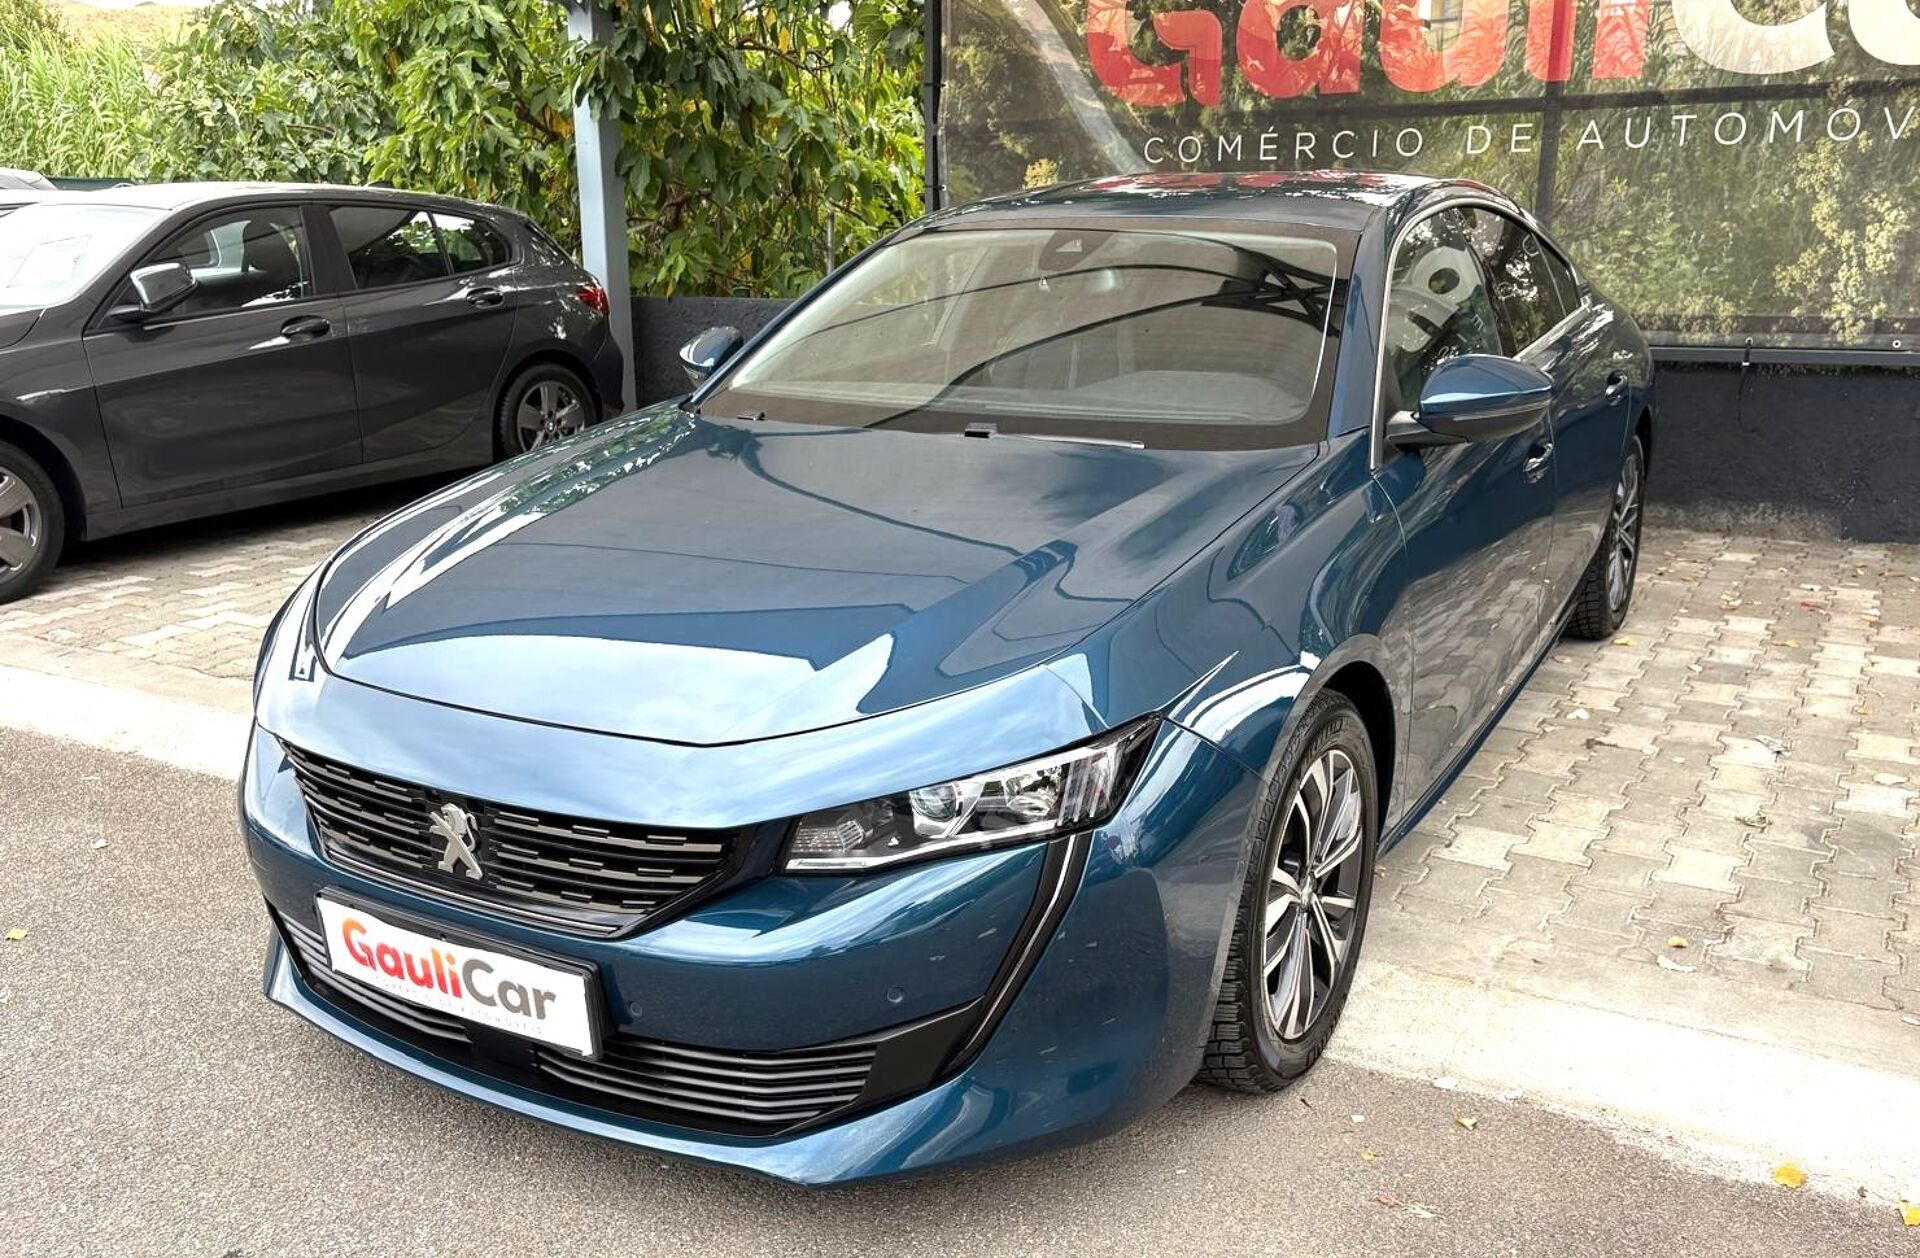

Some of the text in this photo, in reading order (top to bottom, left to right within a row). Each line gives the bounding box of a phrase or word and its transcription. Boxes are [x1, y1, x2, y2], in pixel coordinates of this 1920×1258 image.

[1143, 99, 1916, 164] COMÉRCIO DE AUTOMÓV
[341, 917, 557, 1020] GauliCar
